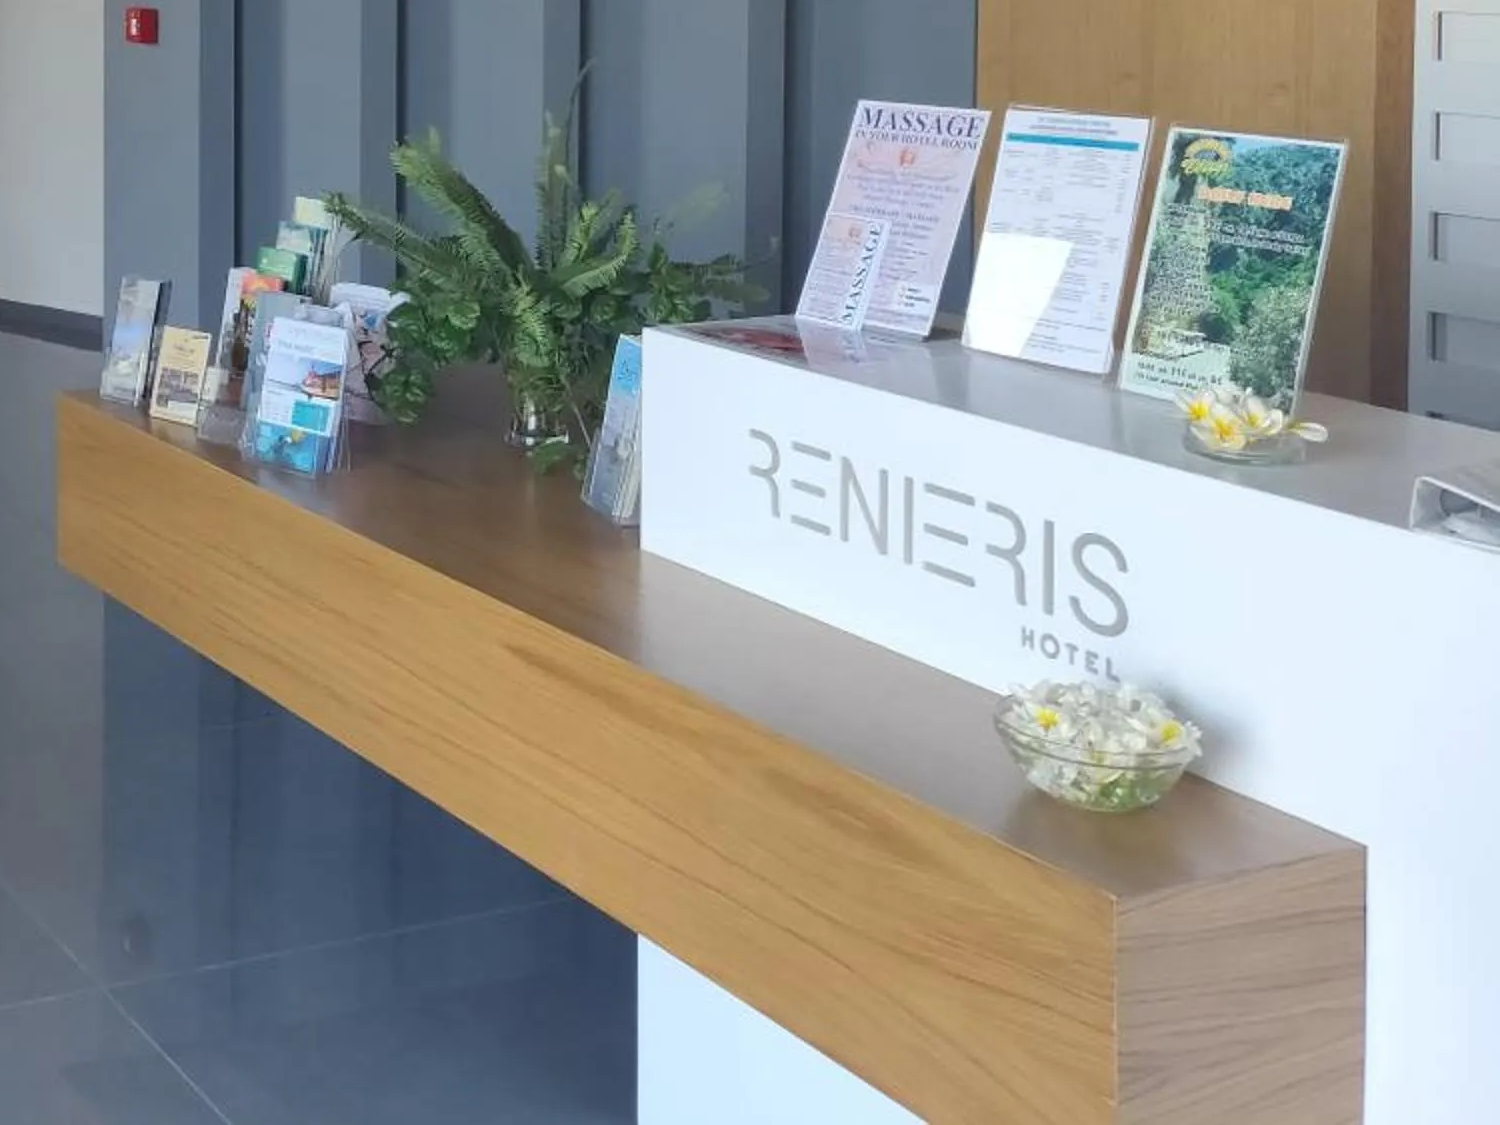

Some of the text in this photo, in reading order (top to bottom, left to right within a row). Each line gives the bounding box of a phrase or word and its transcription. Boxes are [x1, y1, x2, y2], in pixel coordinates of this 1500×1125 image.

[859, 107, 984, 138] MASSAGE
[840, 220, 881, 324] MASSAGE
[748, 428, 1130, 638] RENIERIS
[1021, 626, 1121, 684] HOTEL
